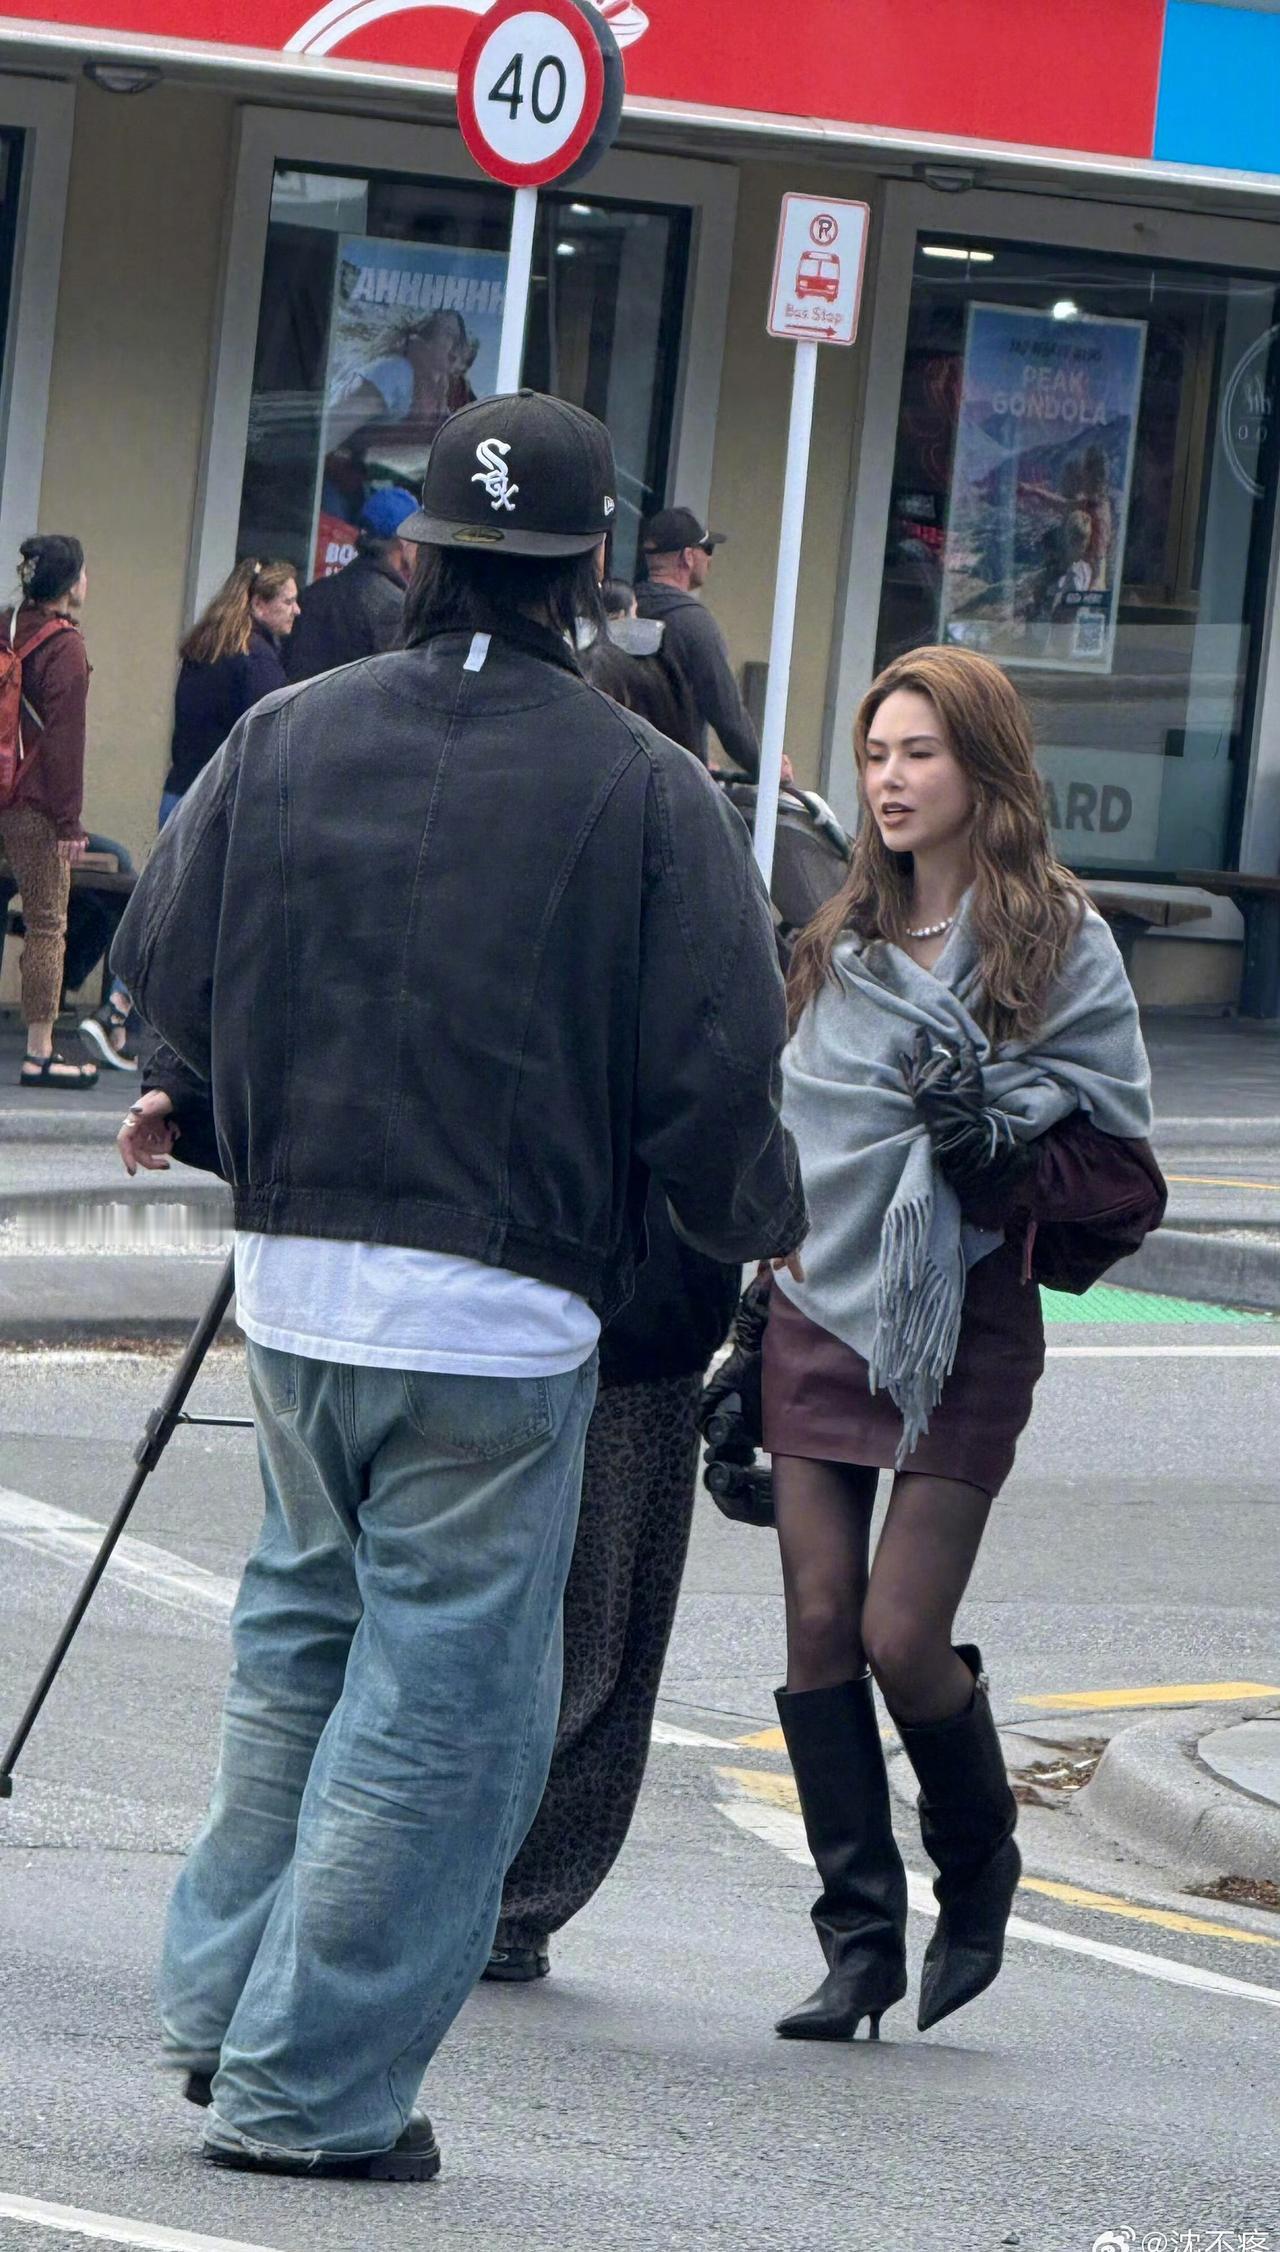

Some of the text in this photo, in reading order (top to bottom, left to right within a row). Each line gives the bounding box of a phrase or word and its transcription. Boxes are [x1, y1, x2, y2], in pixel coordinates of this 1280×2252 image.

[488, 52, 567, 125] 40
[784, 303, 845, 324] Bus Stop
[1023, 364, 1090, 392] PEAK
[991, 390, 1107, 426] GONDOLA
